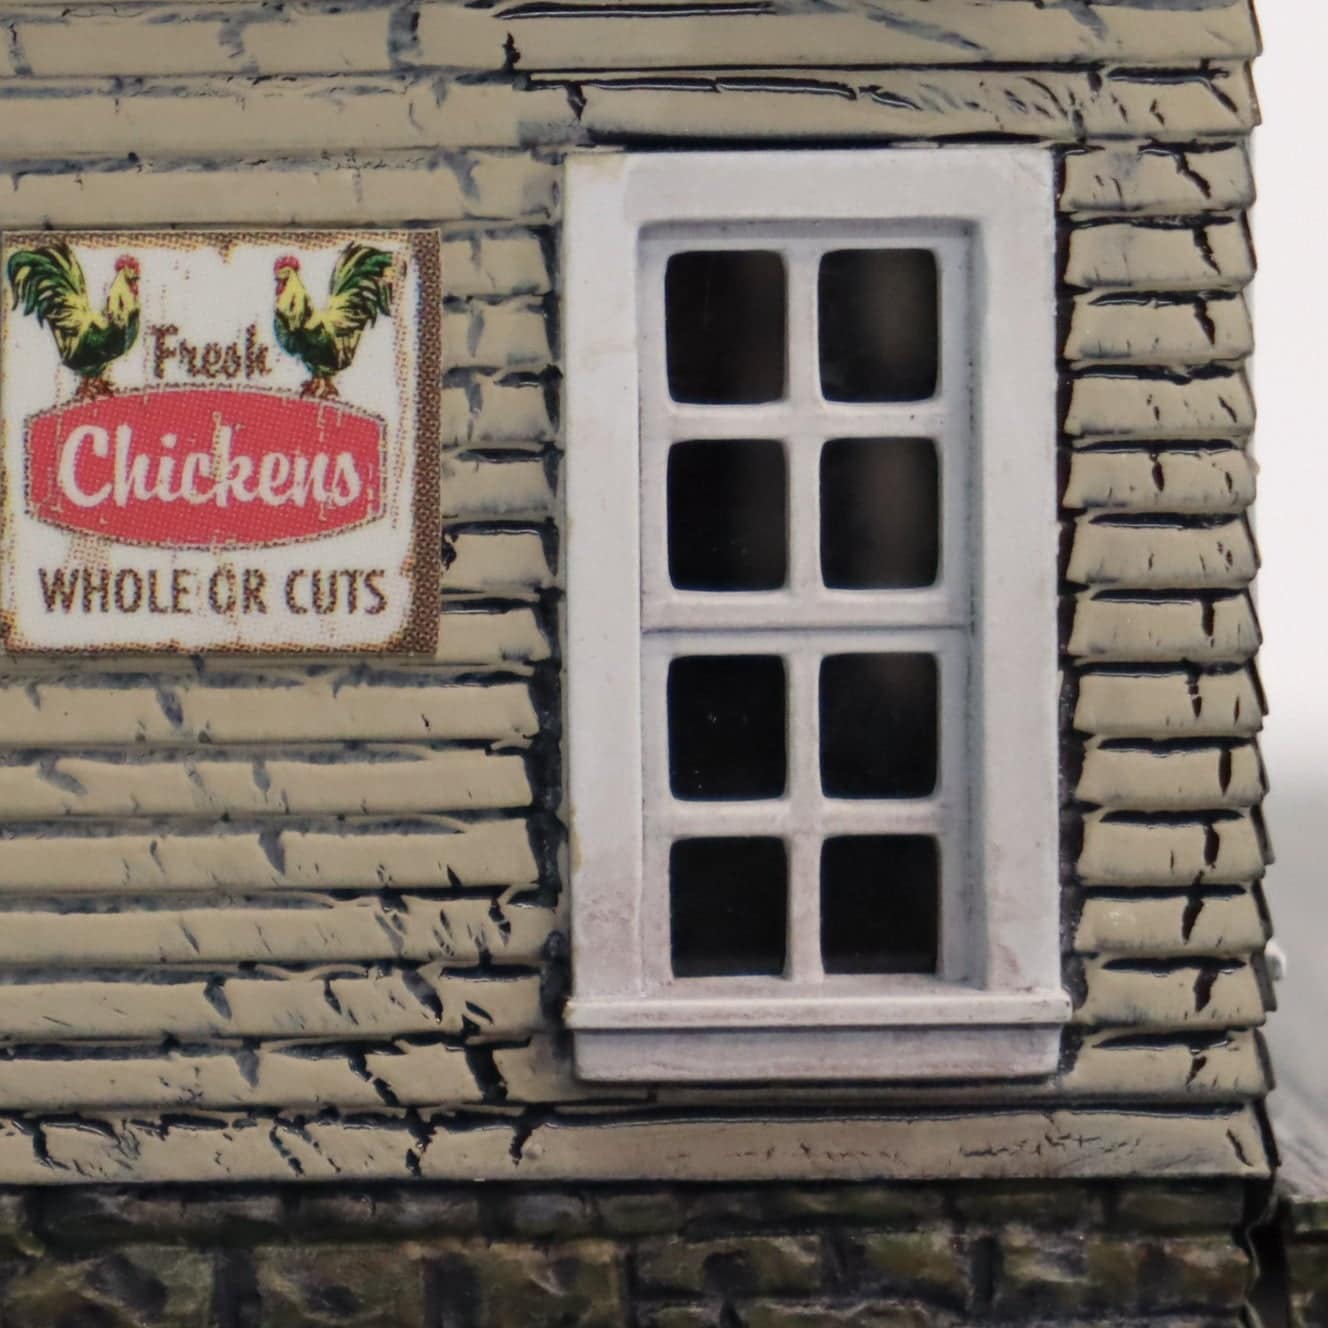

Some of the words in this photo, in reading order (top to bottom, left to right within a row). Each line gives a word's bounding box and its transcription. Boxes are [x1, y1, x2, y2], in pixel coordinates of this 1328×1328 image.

[148, 323, 273, 378] Fresh
[58, 423, 363, 508] Chickens
[38, 567, 193, 615] WHOLE
[208, 567, 267, 615] OR
[285, 567, 388, 615] CUTS
